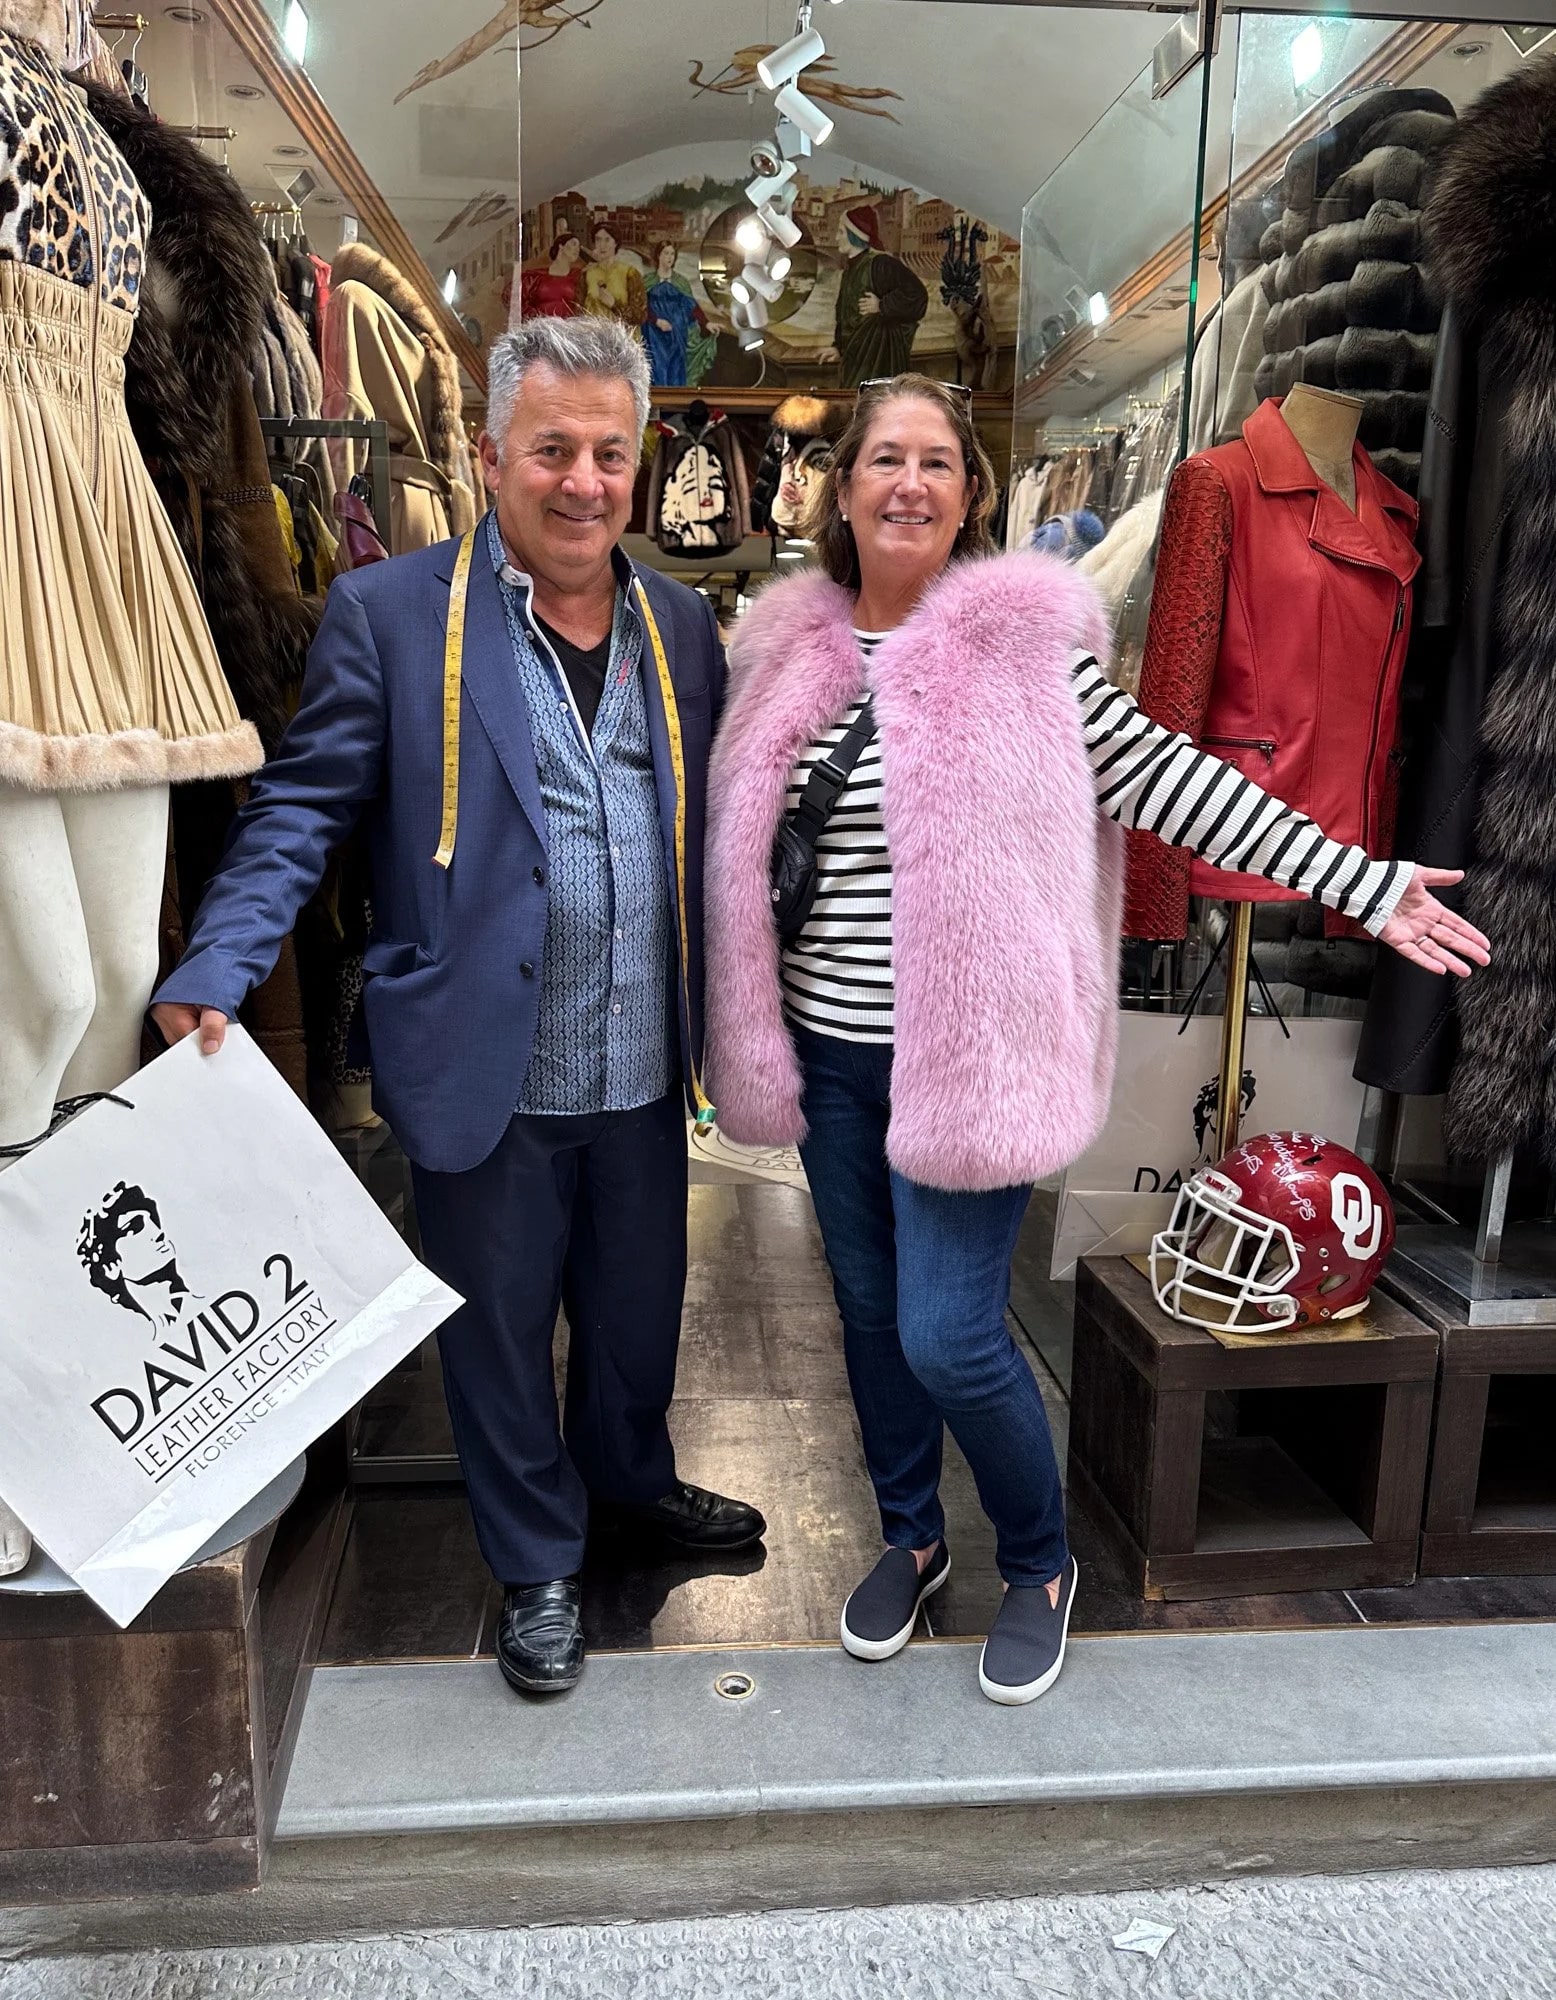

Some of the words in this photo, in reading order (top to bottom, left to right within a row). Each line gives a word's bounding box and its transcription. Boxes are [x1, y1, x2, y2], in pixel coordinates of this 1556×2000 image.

[752, 1159, 800, 1169] DA
[1134, 1167, 1198, 1193] DA
[1330, 1171, 1382, 1261] OU
[90, 1290, 260, 1445] DAVID
[263, 1253, 309, 1304] 2
[135, 1387, 233, 1476] LEATHER
[232, 1297, 328, 1391] FACTORY
[185, 1393, 279, 1478] FLORENCE
[286, 1343, 331, 1386] ITALY
